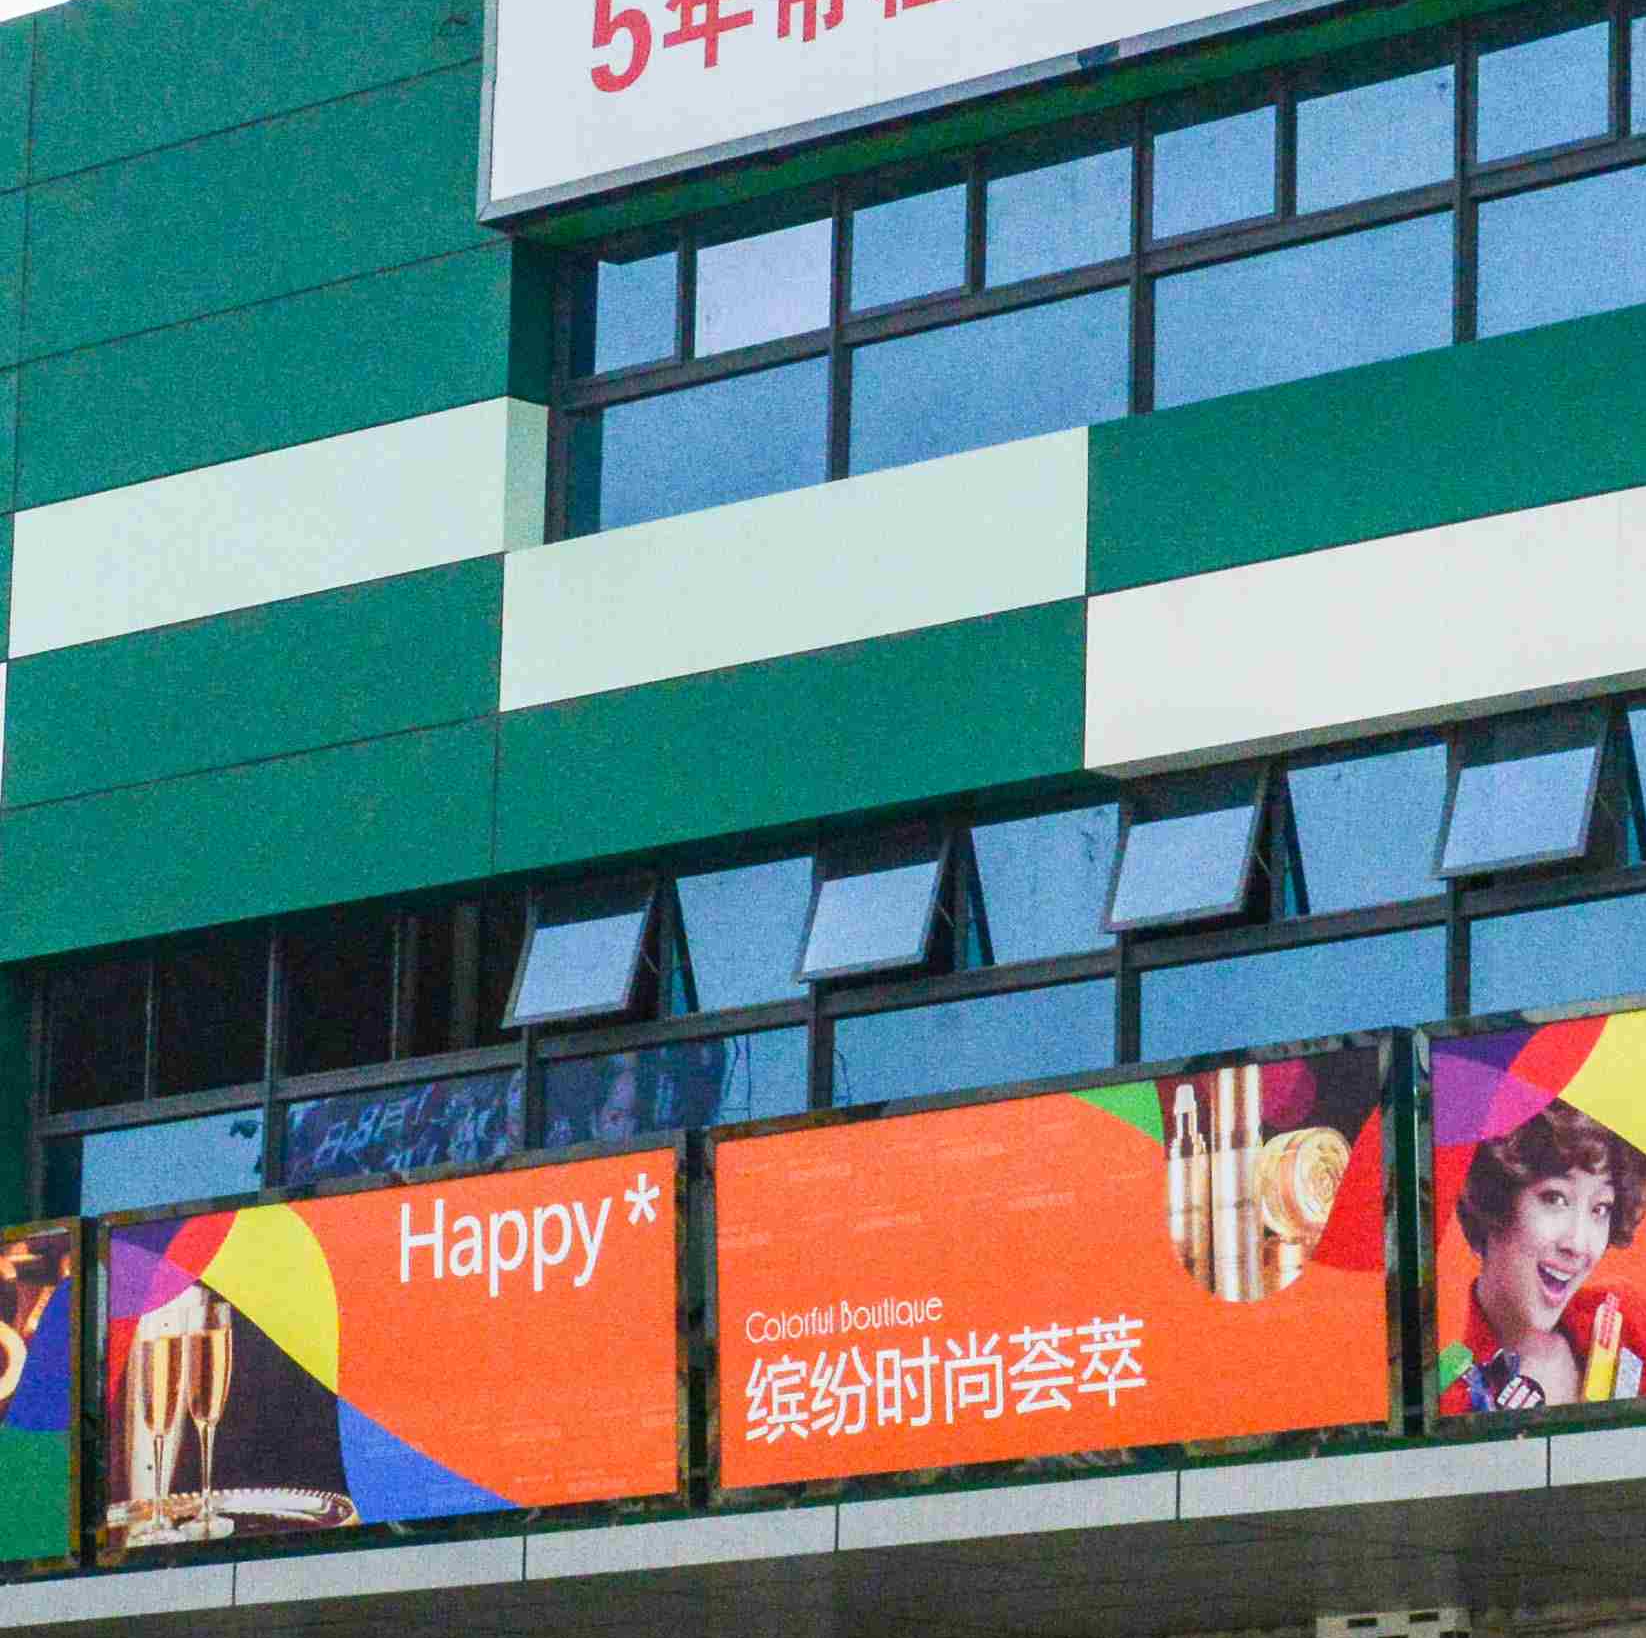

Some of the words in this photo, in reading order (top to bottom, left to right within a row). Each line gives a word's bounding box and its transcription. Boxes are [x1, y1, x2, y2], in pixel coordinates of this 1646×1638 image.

[745, 1304, 835, 1345] Colorful
[839, 1296, 944, 1336] Boutique
[744, 1313, 1148, 1445] 缤纷时尚荟萃
